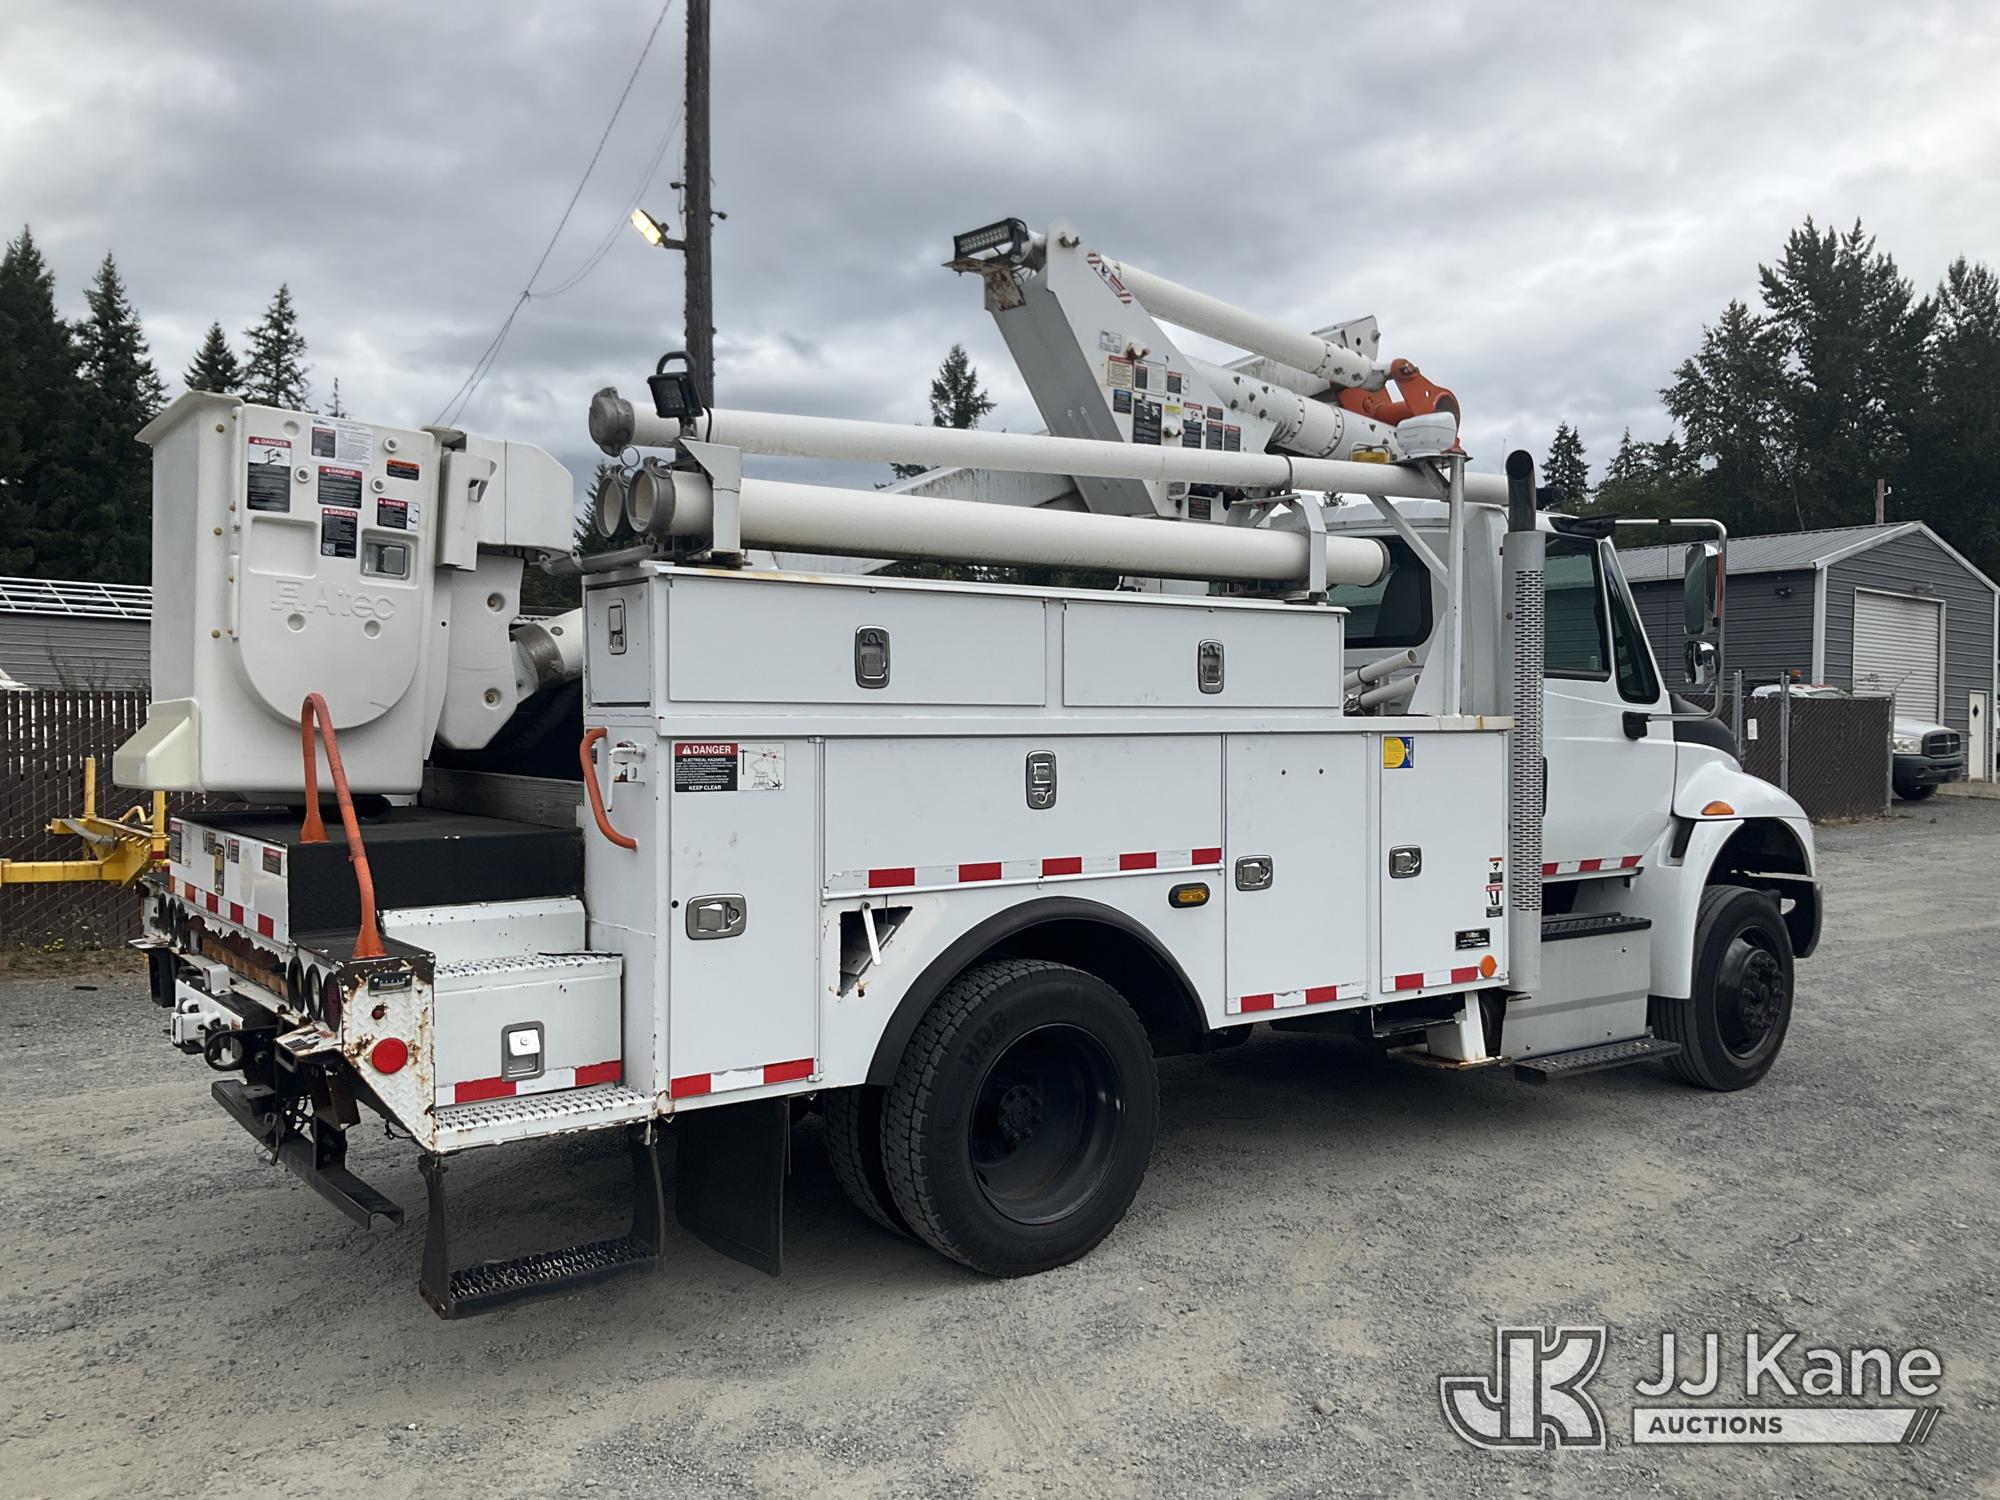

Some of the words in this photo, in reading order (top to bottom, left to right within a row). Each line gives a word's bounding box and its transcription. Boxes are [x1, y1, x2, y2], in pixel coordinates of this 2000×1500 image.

[260, 438, 288, 447] DANGER
[330, 467, 356, 476] DANGER
[329, 509, 357, 518] DANGER
[692, 745, 732, 754] DANGER
